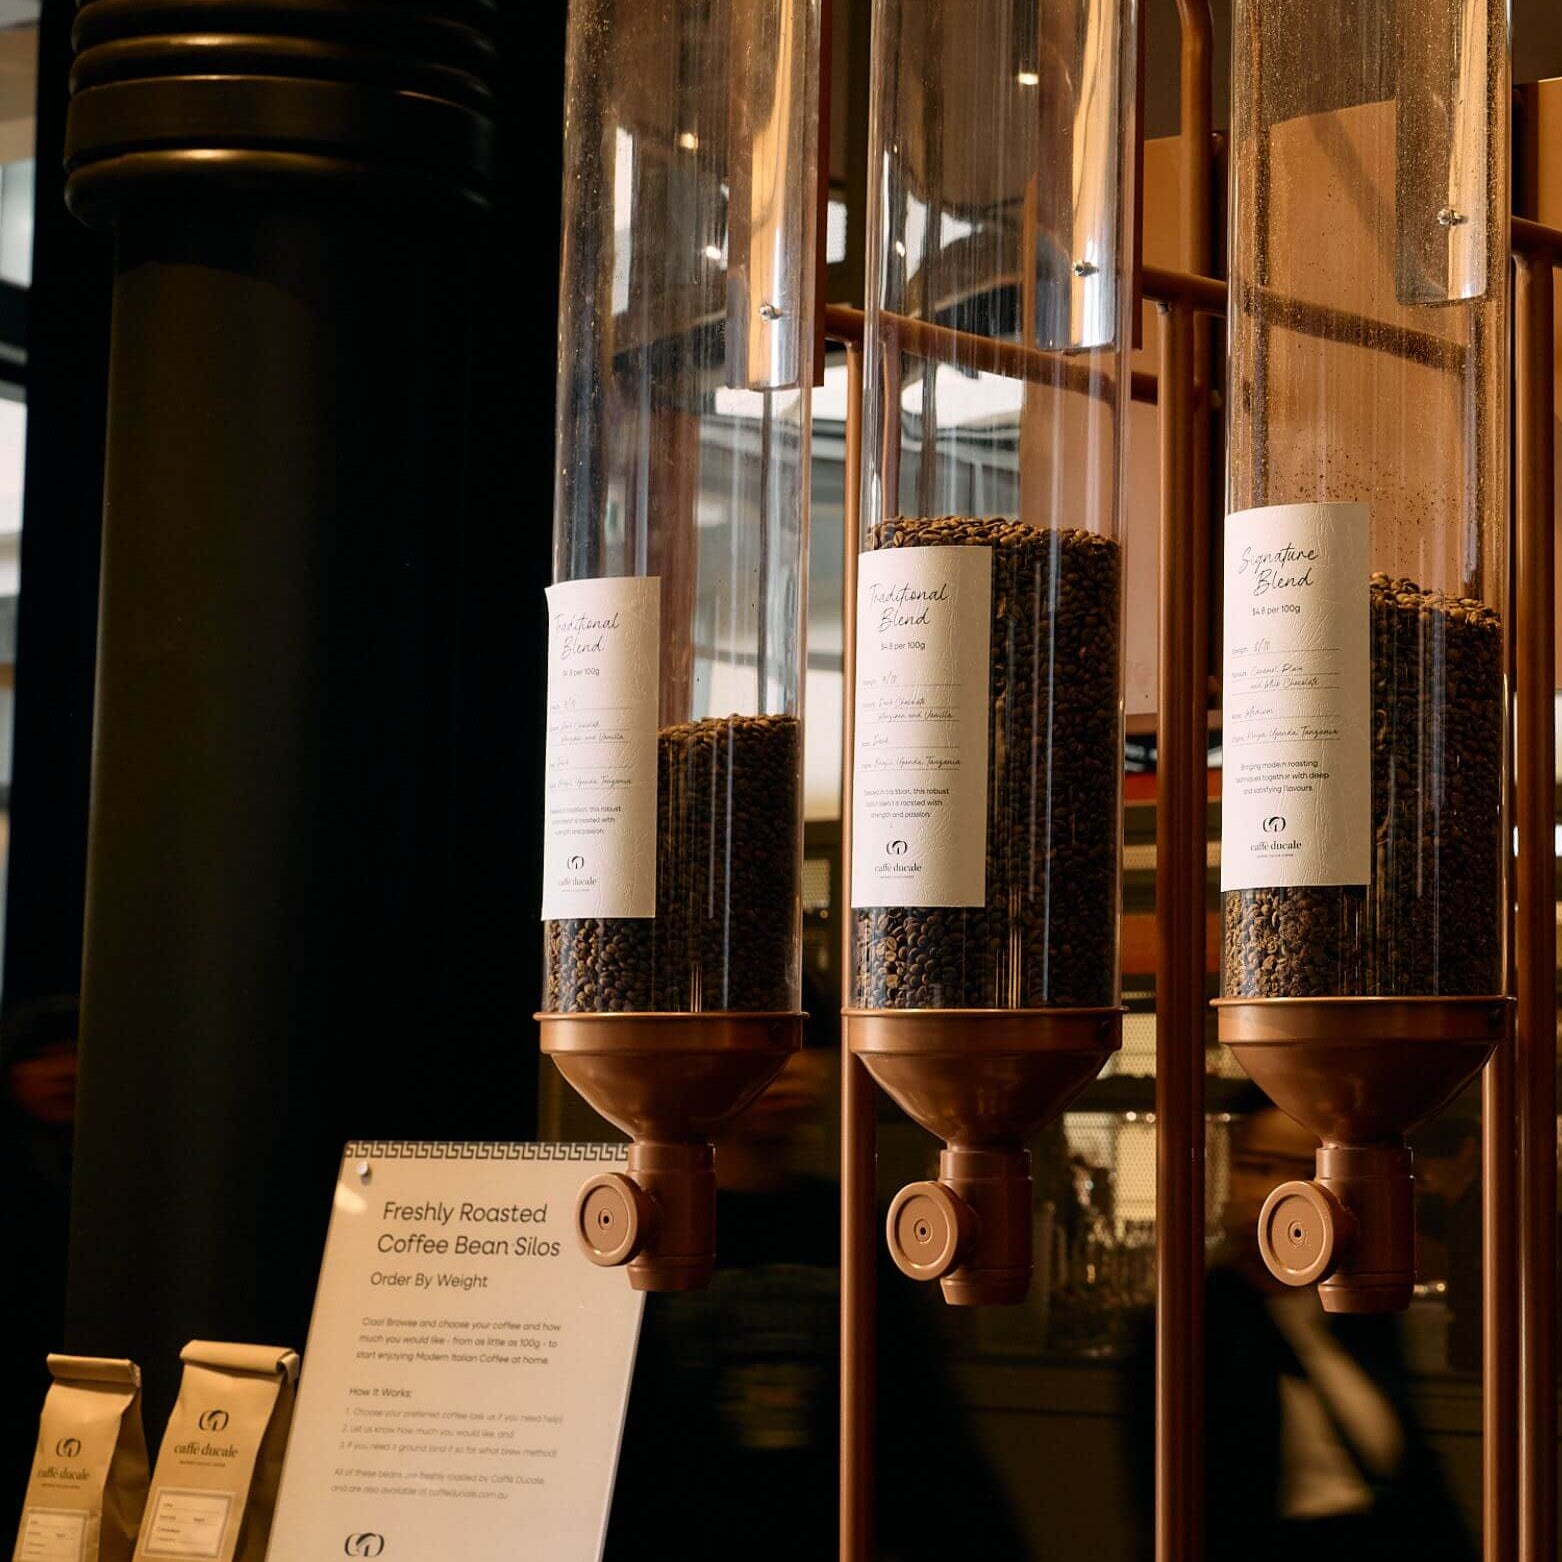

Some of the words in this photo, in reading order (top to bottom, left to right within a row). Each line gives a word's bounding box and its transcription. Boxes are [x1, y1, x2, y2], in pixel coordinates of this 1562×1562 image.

[1238, 542, 1319, 574] Signature
[1253, 567, 1314, 597] Blend
[1267, 607, 1279, 615] per
[1281, 604, 1301, 614] 100g
[878, 607, 931, 633] Blend
[907, 641, 926, 651] 100g
[1288, 760, 1319, 769] roasting
[1292, 772, 1308, 780] with
[1309, 772, 1330, 781] deep
[1270, 840, 1302, 850] ducale
[893, 862, 922, 872] ducale
[383, 1201, 454, 1226] Freshly
[459, 1202, 548, 1223] Roasted
[377, 1233, 449, 1254] Coffee
[454, 1235, 509, 1255] Bean
[514, 1236, 561, 1257] Silos
[370, 1271, 411, 1286] Order
[415, 1273, 433, 1289] By
[437, 1274, 489, 1291] Weight
[419, 1320, 437, 1328] and
[438, 1320, 469, 1329] choose
[471, 1322, 490, 1330] your
[492, 1321, 521, 1330] coffee
[522, 1322, 540, 1331] and
[542, 1323, 561, 1332] how
[359, 1334, 383, 1343] much
[402, 1335, 429, 1344] would
[430, 1336, 445, 1345] like
[452, 1337, 473, 1345] from
[486, 1337, 506, 1347] little
[519, 1339, 540, 1349] 100g
[548, 1340, 558, 1348] to
[356, 1351, 376, 1359] start
[378, 1352, 414, 1362] enjoying
[416, 1352, 449, 1361] Modern
[451, 1353, 478, 1363] Italian
[479, 1354, 509, 1363] Coffee
[511, 1356, 521, 1364] at
[350, 1388, 370, 1397] How
[372, 1388, 379, 1397] It
[201, 1443, 239, 1459] ducale
